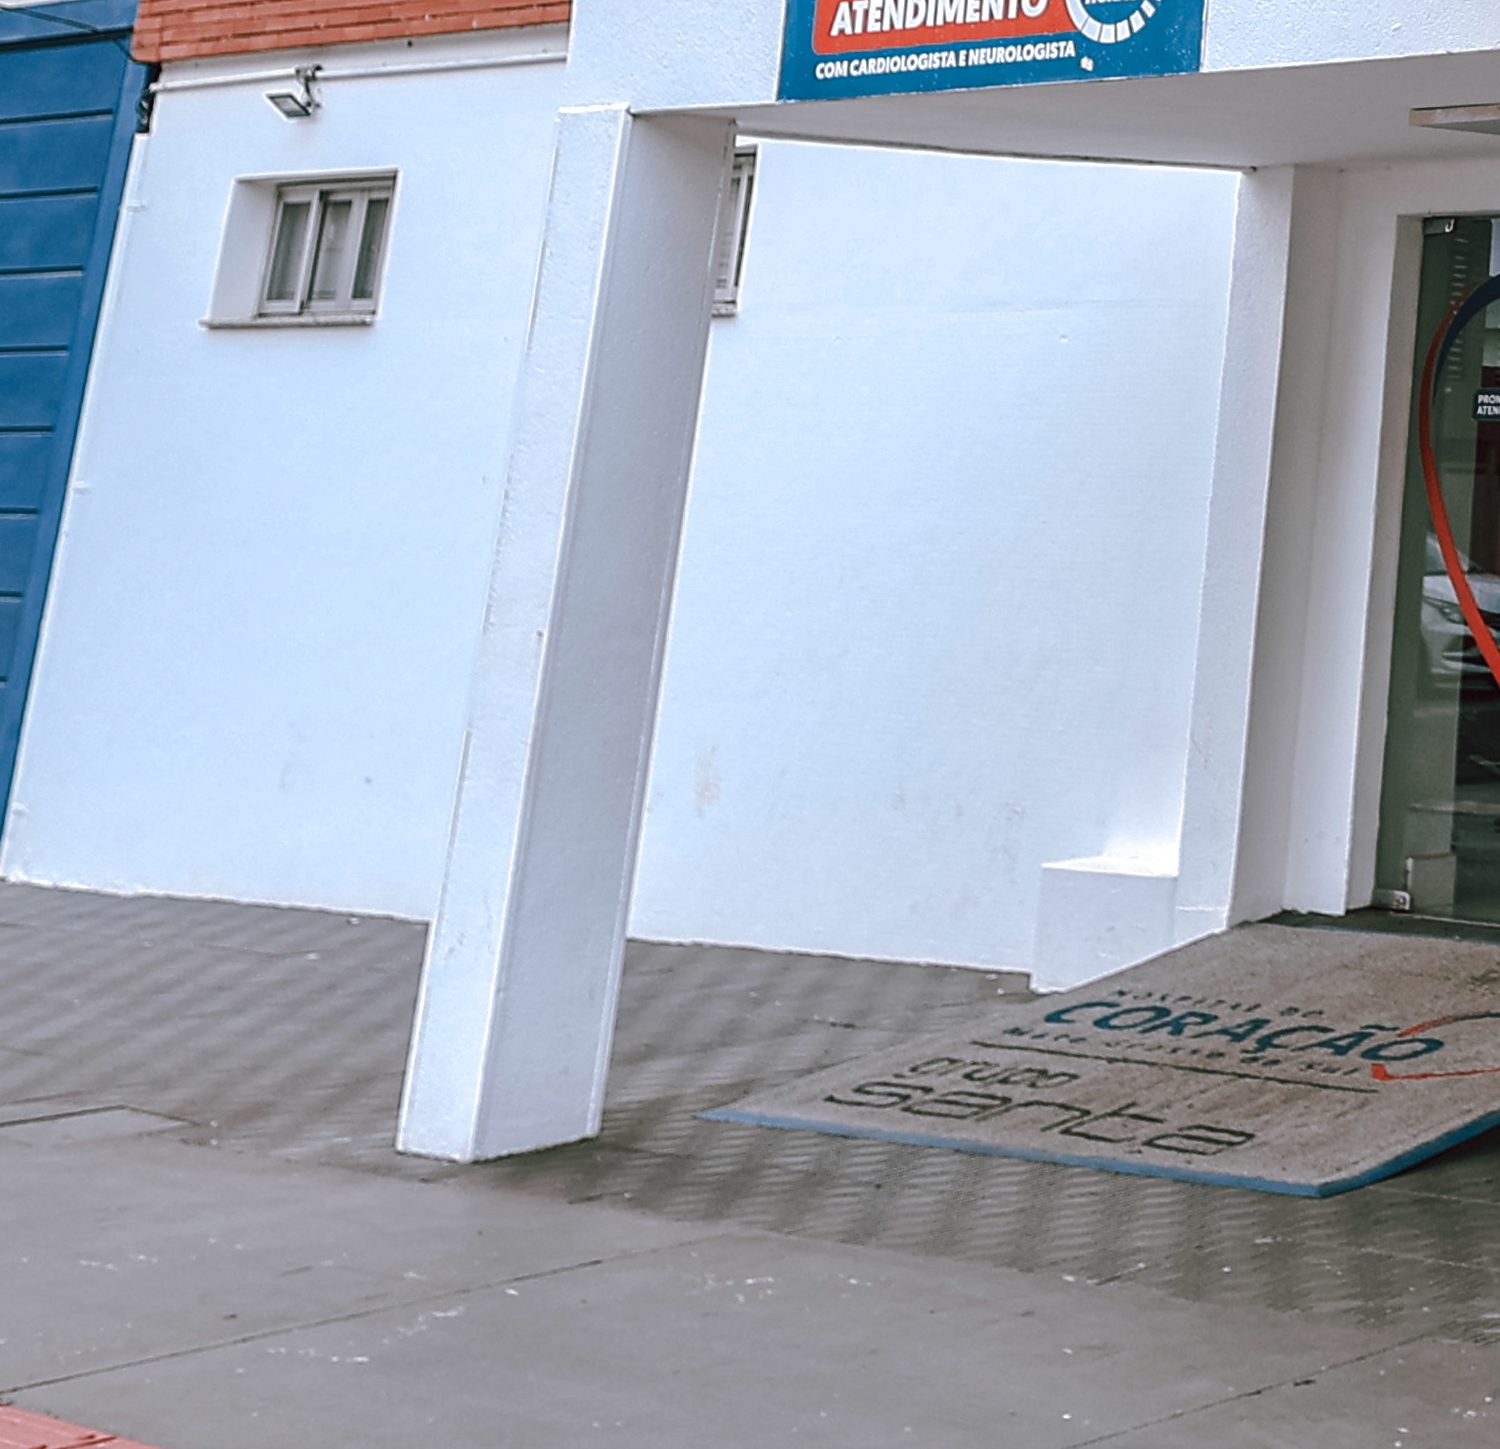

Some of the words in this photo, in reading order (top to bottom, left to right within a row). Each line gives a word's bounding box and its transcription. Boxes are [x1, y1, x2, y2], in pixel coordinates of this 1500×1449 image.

[814, 59, 848, 80] COM
[849, 50, 957, 77] CARDIOLOGISTA
[958, 51, 967, 67] E
[968, 39, 1076, 67] NEUROLOGISTA
[1044, 1001, 1445, 1062] CORAÇÃO
